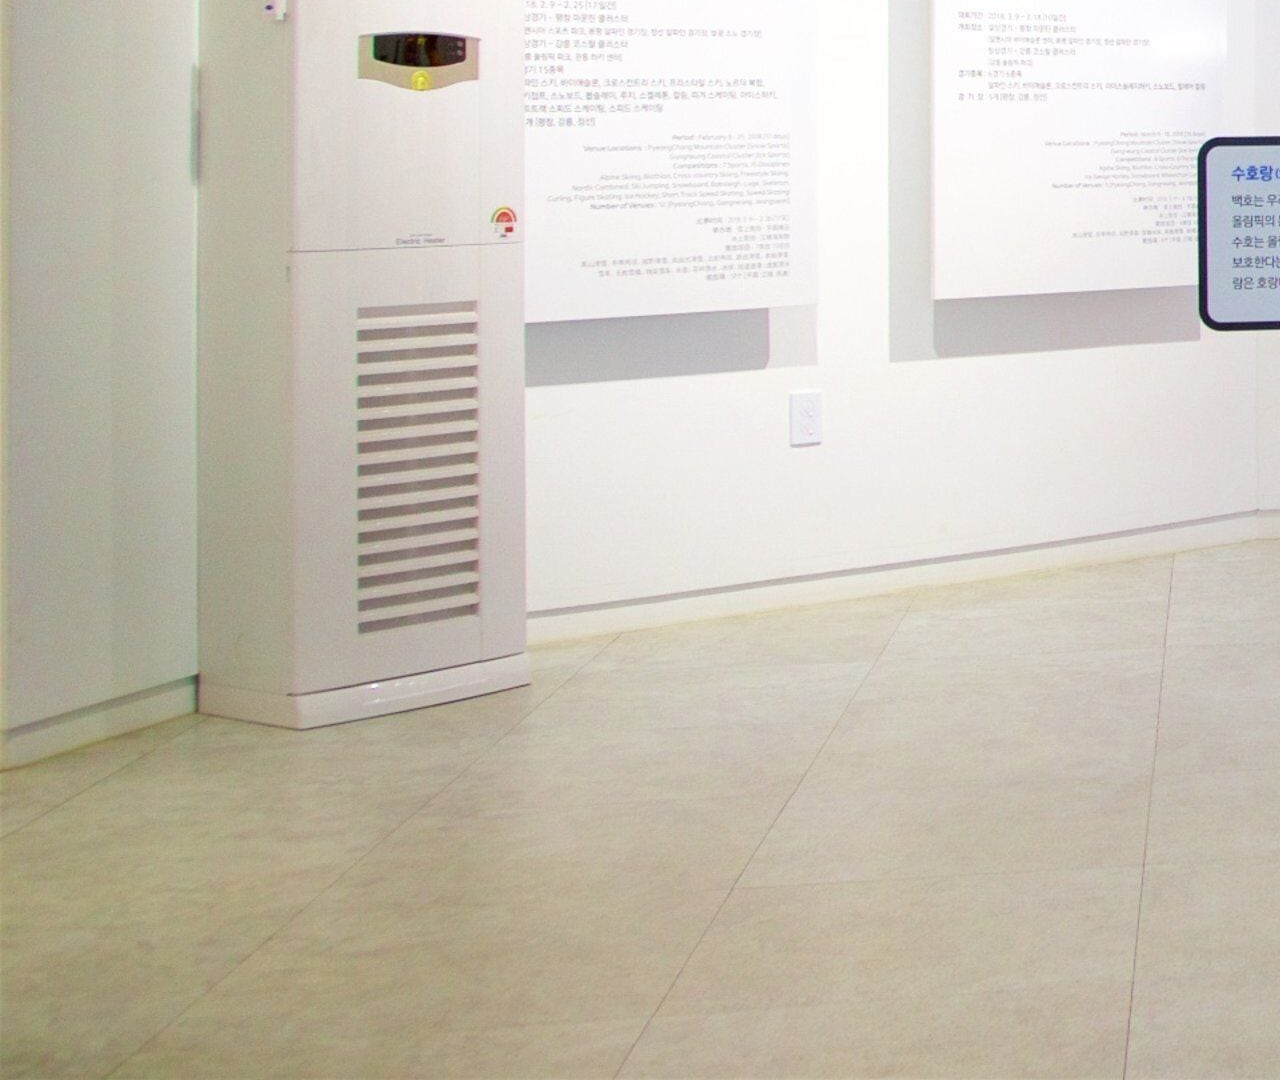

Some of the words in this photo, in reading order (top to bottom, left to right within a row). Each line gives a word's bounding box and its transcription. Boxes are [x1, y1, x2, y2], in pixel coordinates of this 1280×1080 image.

[1232, 194, 1264, 208] 백호는
[1232, 214, 1275, 229] 올림픽의
[1232, 235, 1264, 249] 수호는
[1232, 276, 1254, 290] 랑은
